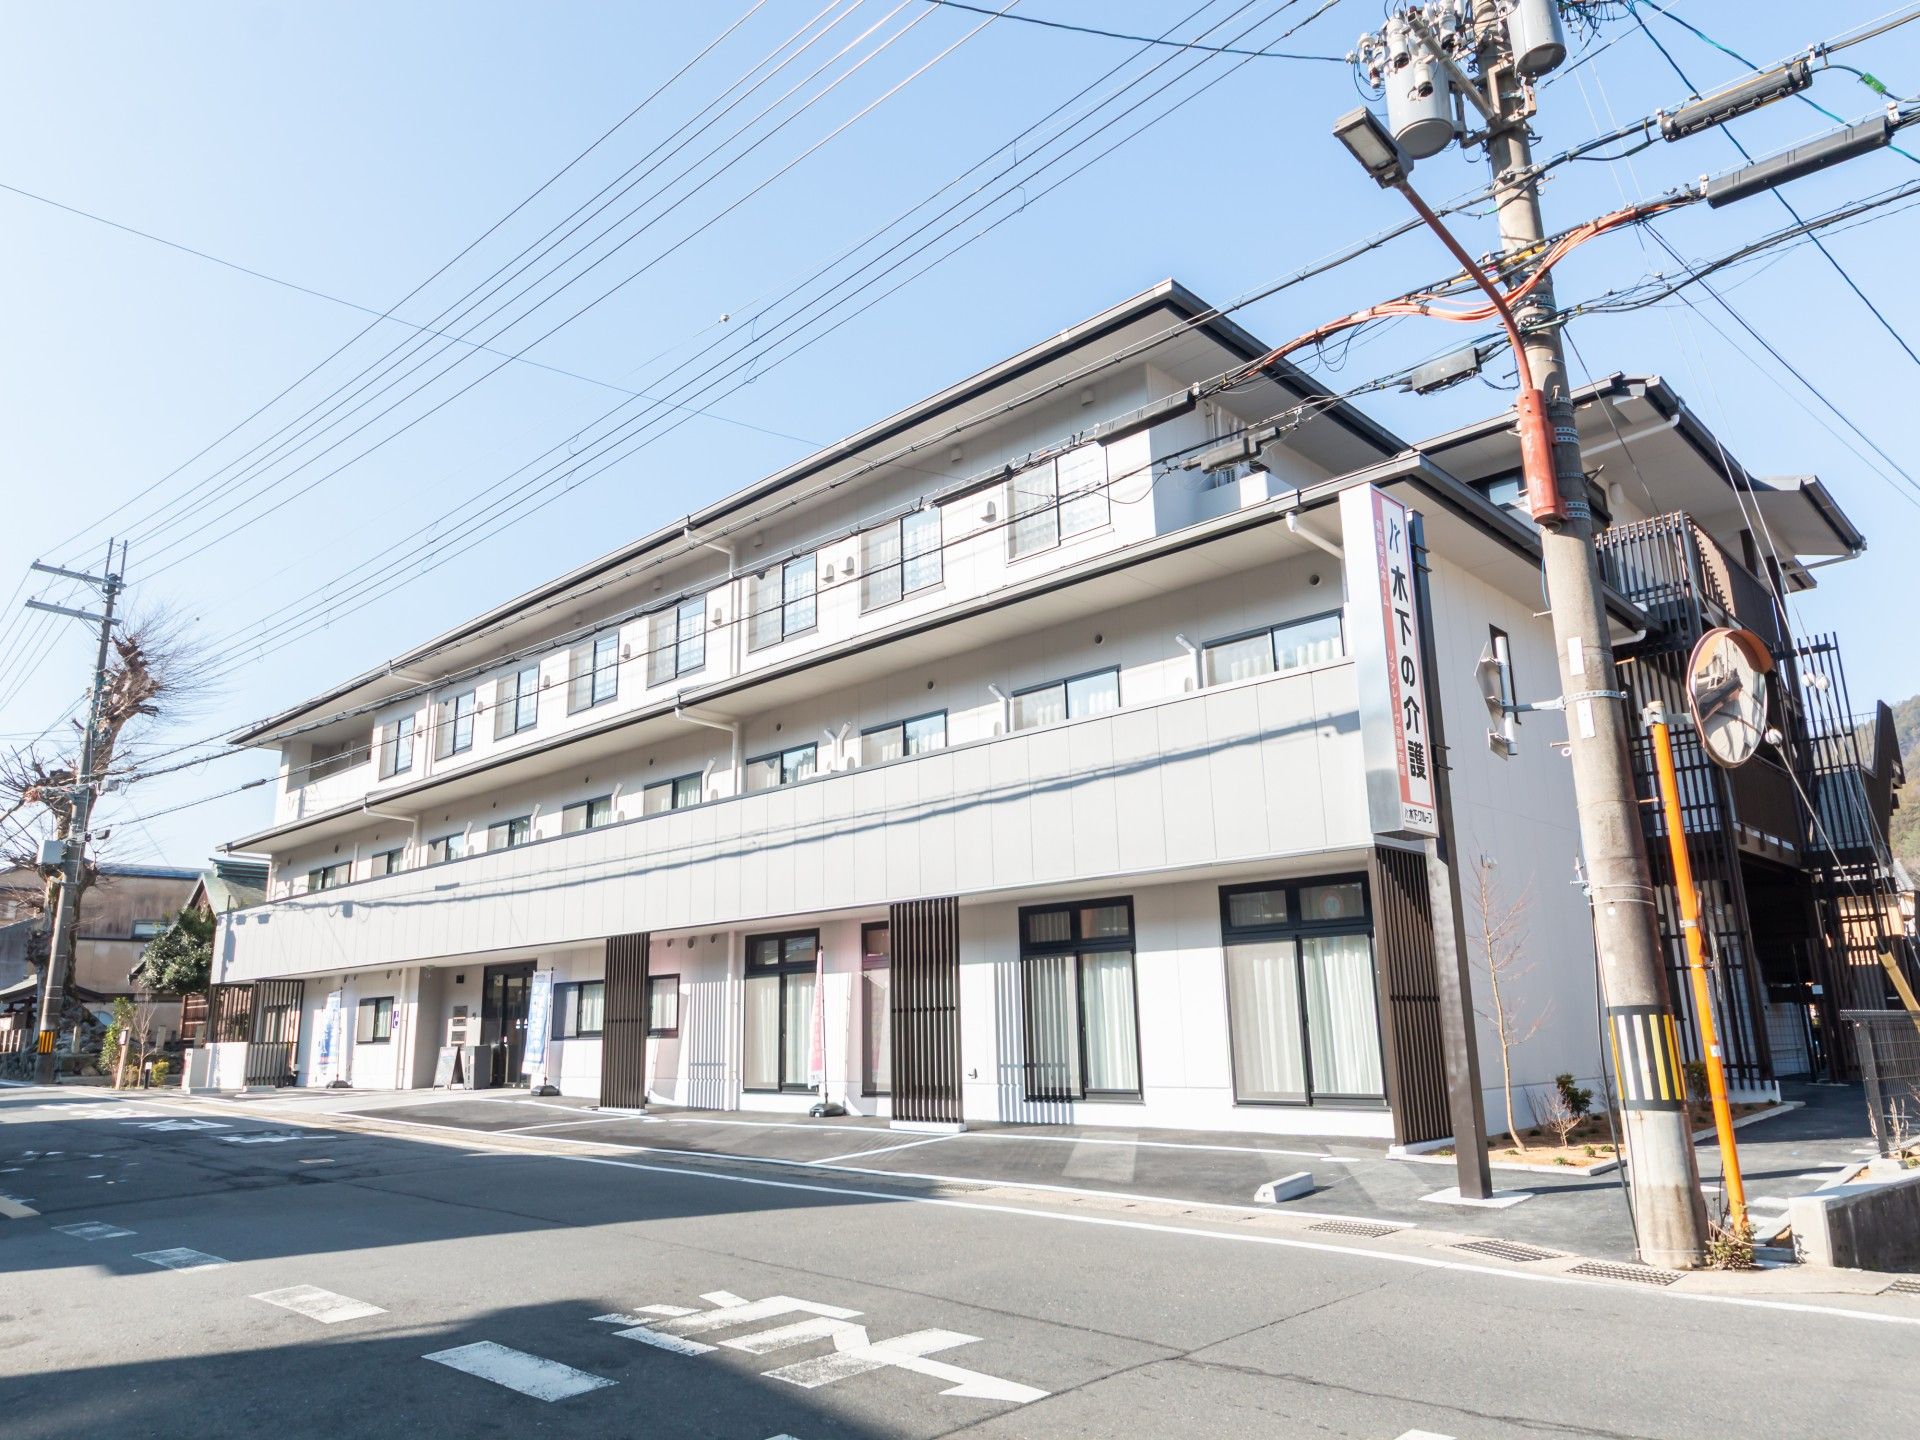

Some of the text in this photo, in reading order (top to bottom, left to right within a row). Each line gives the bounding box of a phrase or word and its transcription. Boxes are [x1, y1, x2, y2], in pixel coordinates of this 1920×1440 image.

[1390, 565, 1427, 781] 木下の介護
[588, 1290, 1051, 1403] 学
